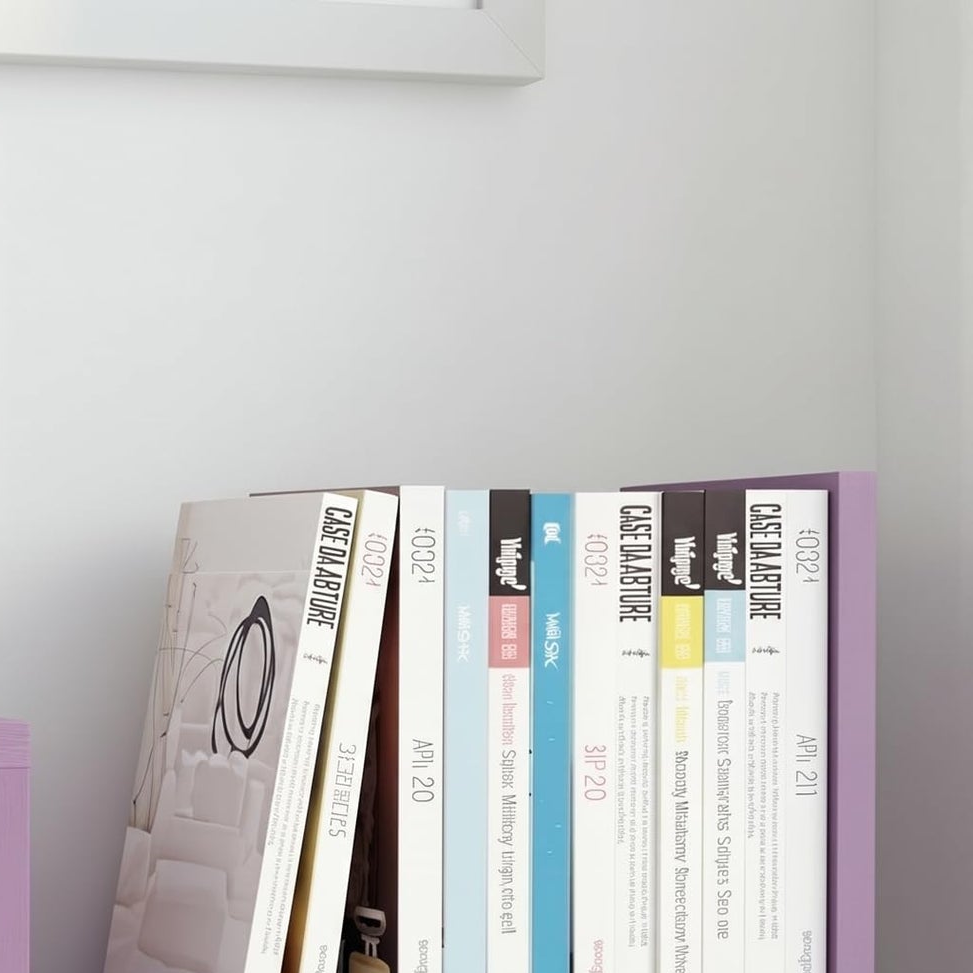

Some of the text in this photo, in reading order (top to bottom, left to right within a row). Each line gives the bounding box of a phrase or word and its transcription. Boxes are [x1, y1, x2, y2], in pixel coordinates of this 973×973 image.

[320, 506, 353, 547] CASE
[619, 505, 653, 541] CASE
[749, 503, 783, 538] CASE
[410, 775, 435, 805] 20
[585, 774, 607, 802] 20
